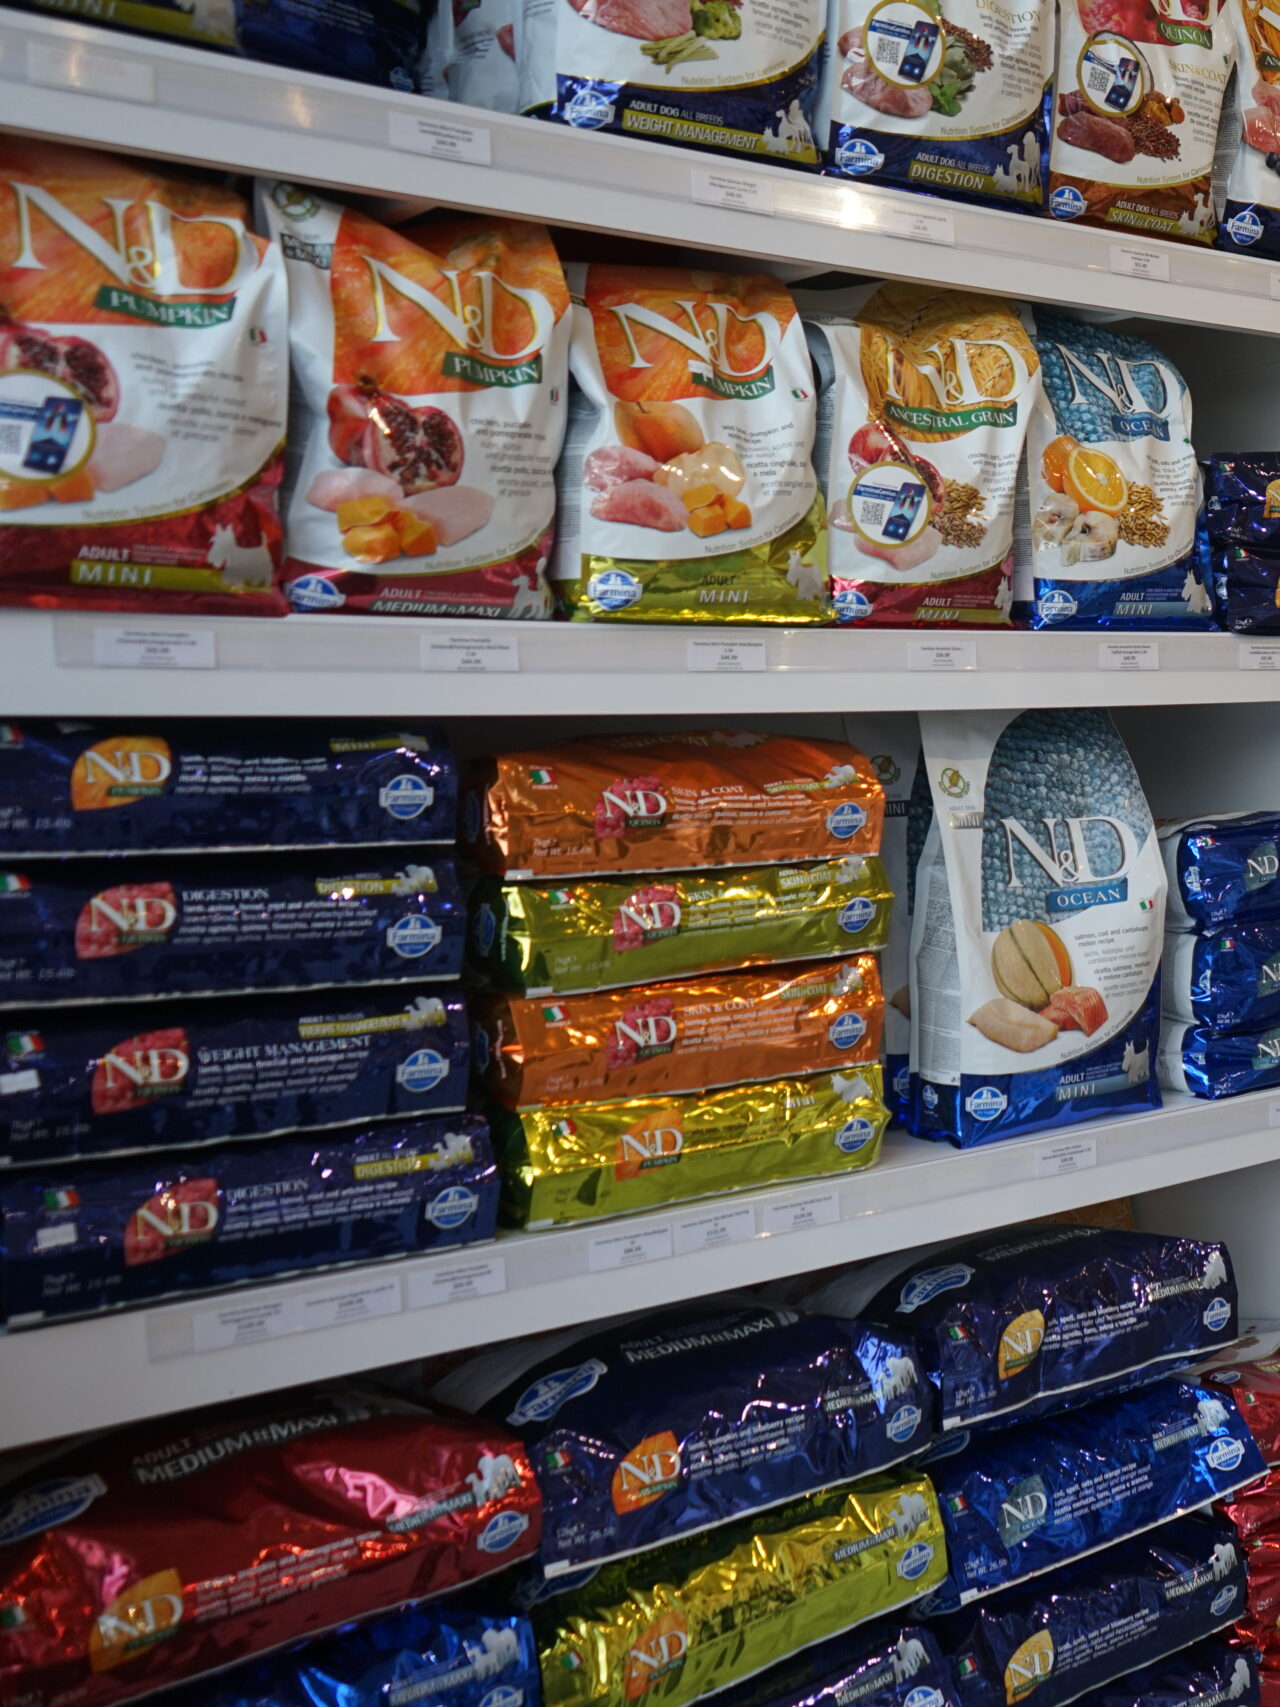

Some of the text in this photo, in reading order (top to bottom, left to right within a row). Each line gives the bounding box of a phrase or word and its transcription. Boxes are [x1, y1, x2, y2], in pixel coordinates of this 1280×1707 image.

[1160, 25, 1210, 47] QUINOA
[630, 100, 724, 126] ADULT DOG ALL BREEDS
[626, 115, 759, 150] WEIGHT MANAGEMENT
[838, 152, 881, 167] Farmina
[916, 152, 990, 174] ADULT DOG ALL BREEDS
[911, 164, 985, 190] DIGESTION
[1050, 199, 1083, 213] Farmina
[1116, 200, 1135, 212] ADULT
[1136, 205, 1149, 214] DOG
[1150, 207, 1158, 215] ALL
[1230, 222, 1260, 236] Farmina
[110, 290, 229, 326] PUMPKIN
[454, 356, 539, 384] PUMPKIN
[889, 404, 1014, 429] ANCESTRAL GRAIN
[1120, 420, 1164, 438] OCEAN
[78, 545, 130, 563] ADULT
[78, 564, 152, 584] MINI
[380, 588, 422, 600] ADULT
[699, 589, 749, 604] MINI
[922, 597, 951, 608] ADULT
[1120, 592, 1145, 602] ADULT
[1116, 603, 1153, 615] MINI
[953, 815, 980, 828] MINI
[182, 887, 270, 901] DIGESTION
[1056, 888, 1121, 908] OCEAN
[839, 910, 875, 922] Farmina
[389, 928, 438, 945] Farmina
[1097, 938, 1115, 947] recipe
[830, 1025, 865, 1038] Farmina
[264, 1035, 371, 1059] MANAGEMENT
[1060, 1046, 1084, 1058] Nutrition
[398, 1062, 448, 1081] Farmina
[1059, 1072, 1084, 1085] ADULT
[1059, 1083, 1096, 1100] MINI
[837, 1129, 873, 1142] Farmina
[226, 1179, 308, 1202] DIGESTION
[428, 1199, 477, 1217] Farmina
[1204, 1309, 1232, 1322] Farmina
[1208, 1445, 1243, 1463] Farmina
[1022, 1517, 1047, 1531] OCEAN
[899, 1550, 933, 1570] Farmina
